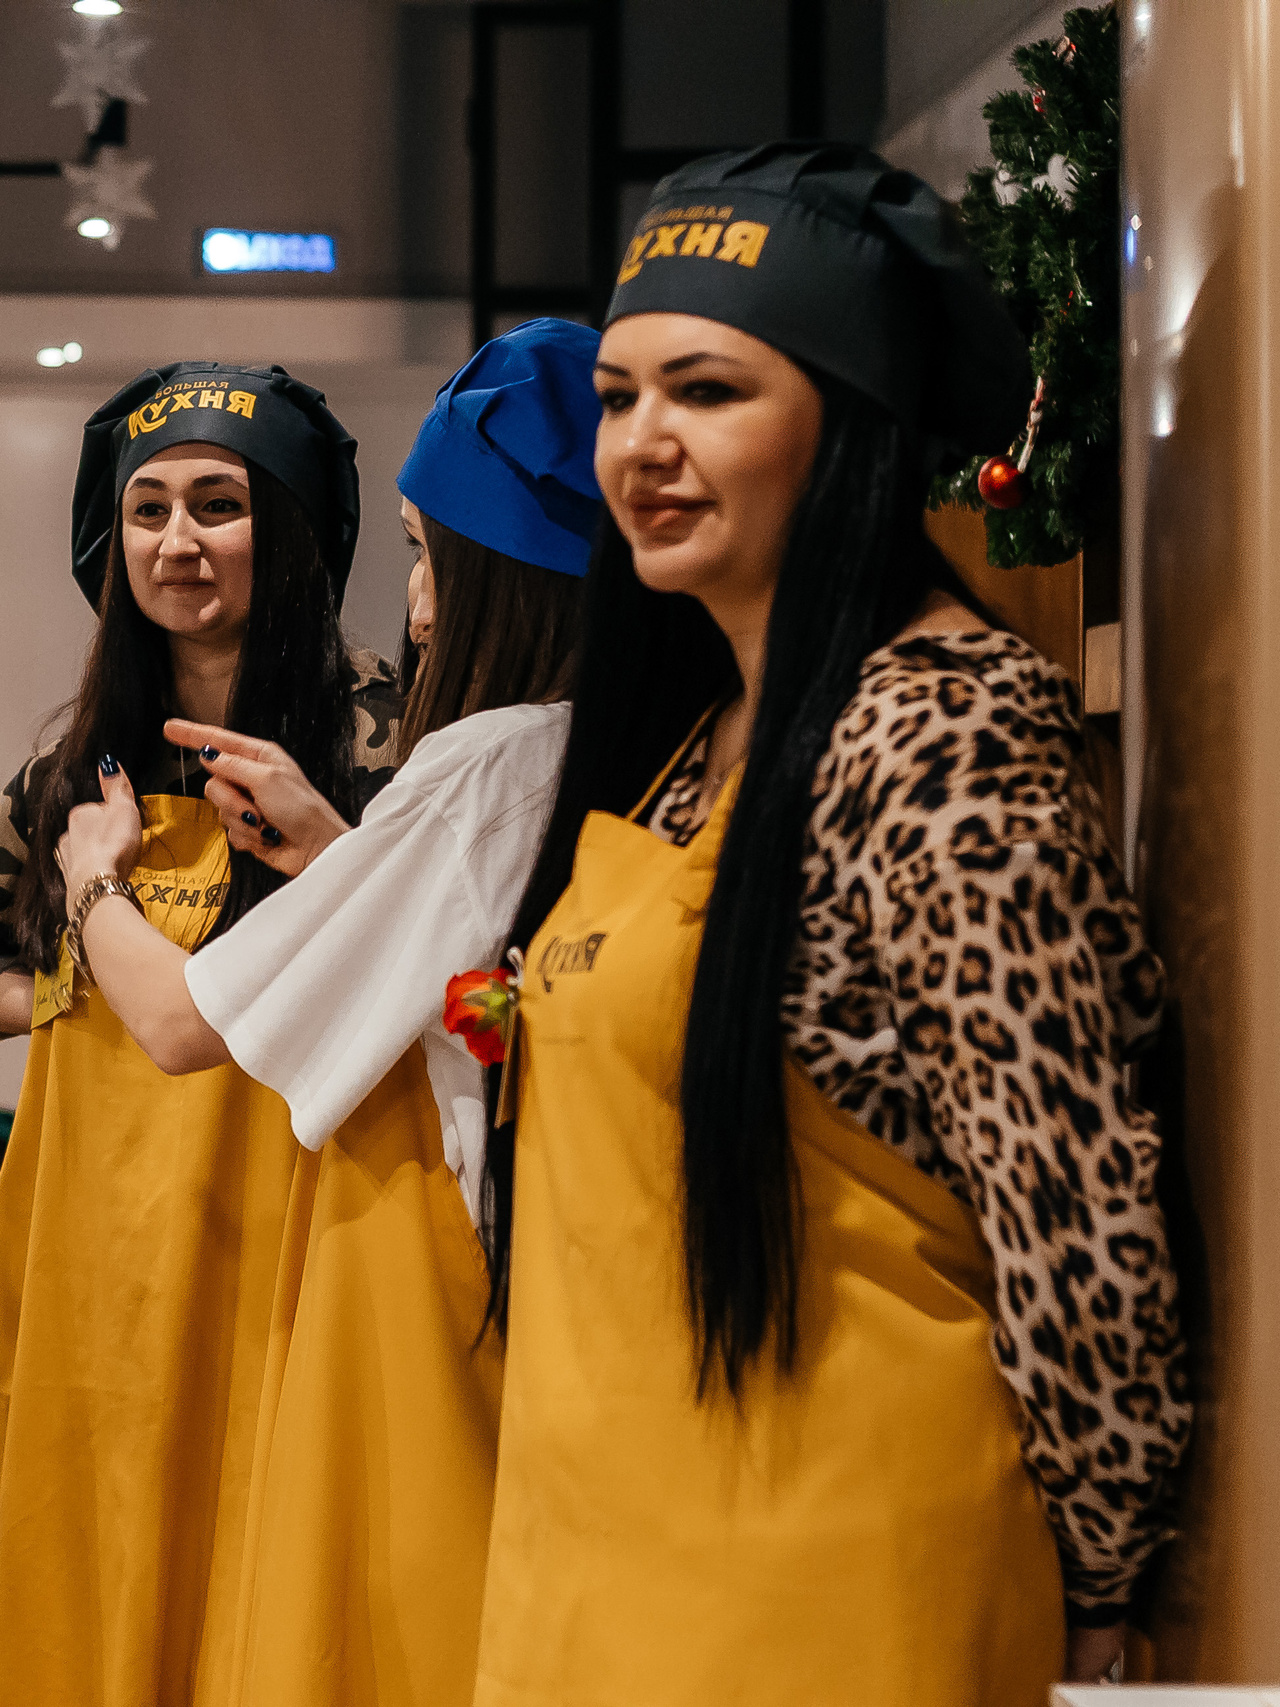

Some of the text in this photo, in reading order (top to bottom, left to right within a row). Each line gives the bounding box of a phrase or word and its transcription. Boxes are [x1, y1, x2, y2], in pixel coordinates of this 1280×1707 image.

[155, 381, 229, 399] БОЛЬШАЯ
[128, 390, 257, 440] КУХНЯ
[128, 881, 231, 909] УХНЯ
